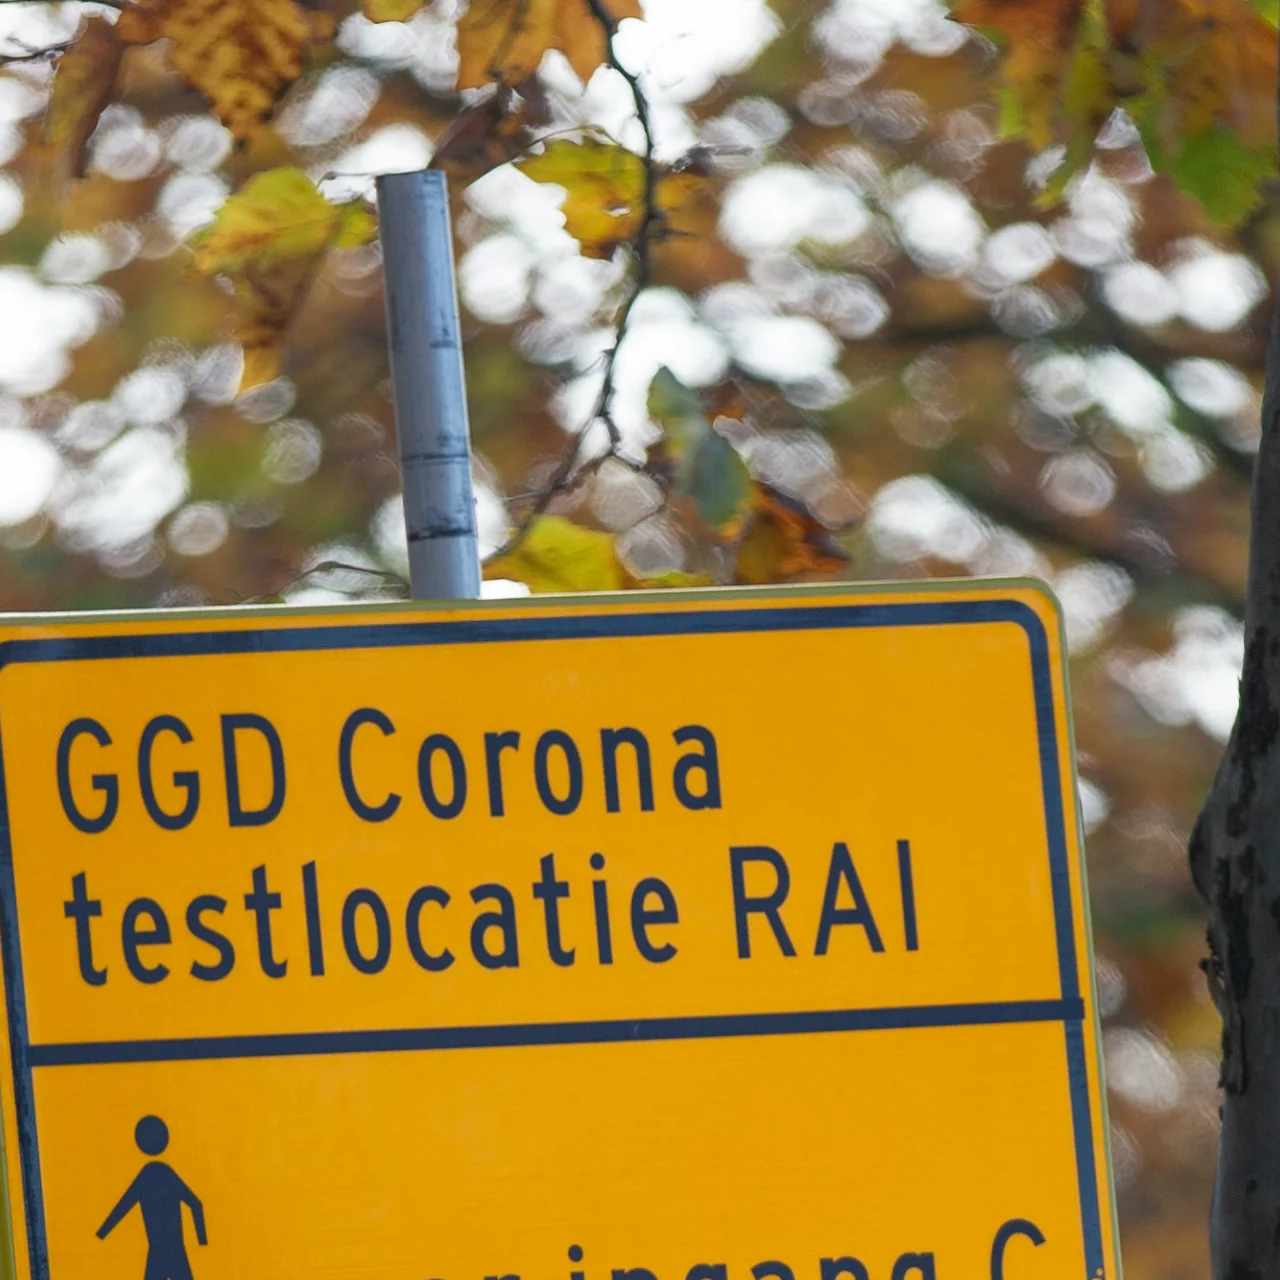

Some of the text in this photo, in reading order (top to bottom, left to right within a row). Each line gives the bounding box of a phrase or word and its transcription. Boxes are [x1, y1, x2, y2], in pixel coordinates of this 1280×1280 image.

[55, 706, 723, 835] GGD Corona
[62, 838, 920, 988] testlocatie RAI
